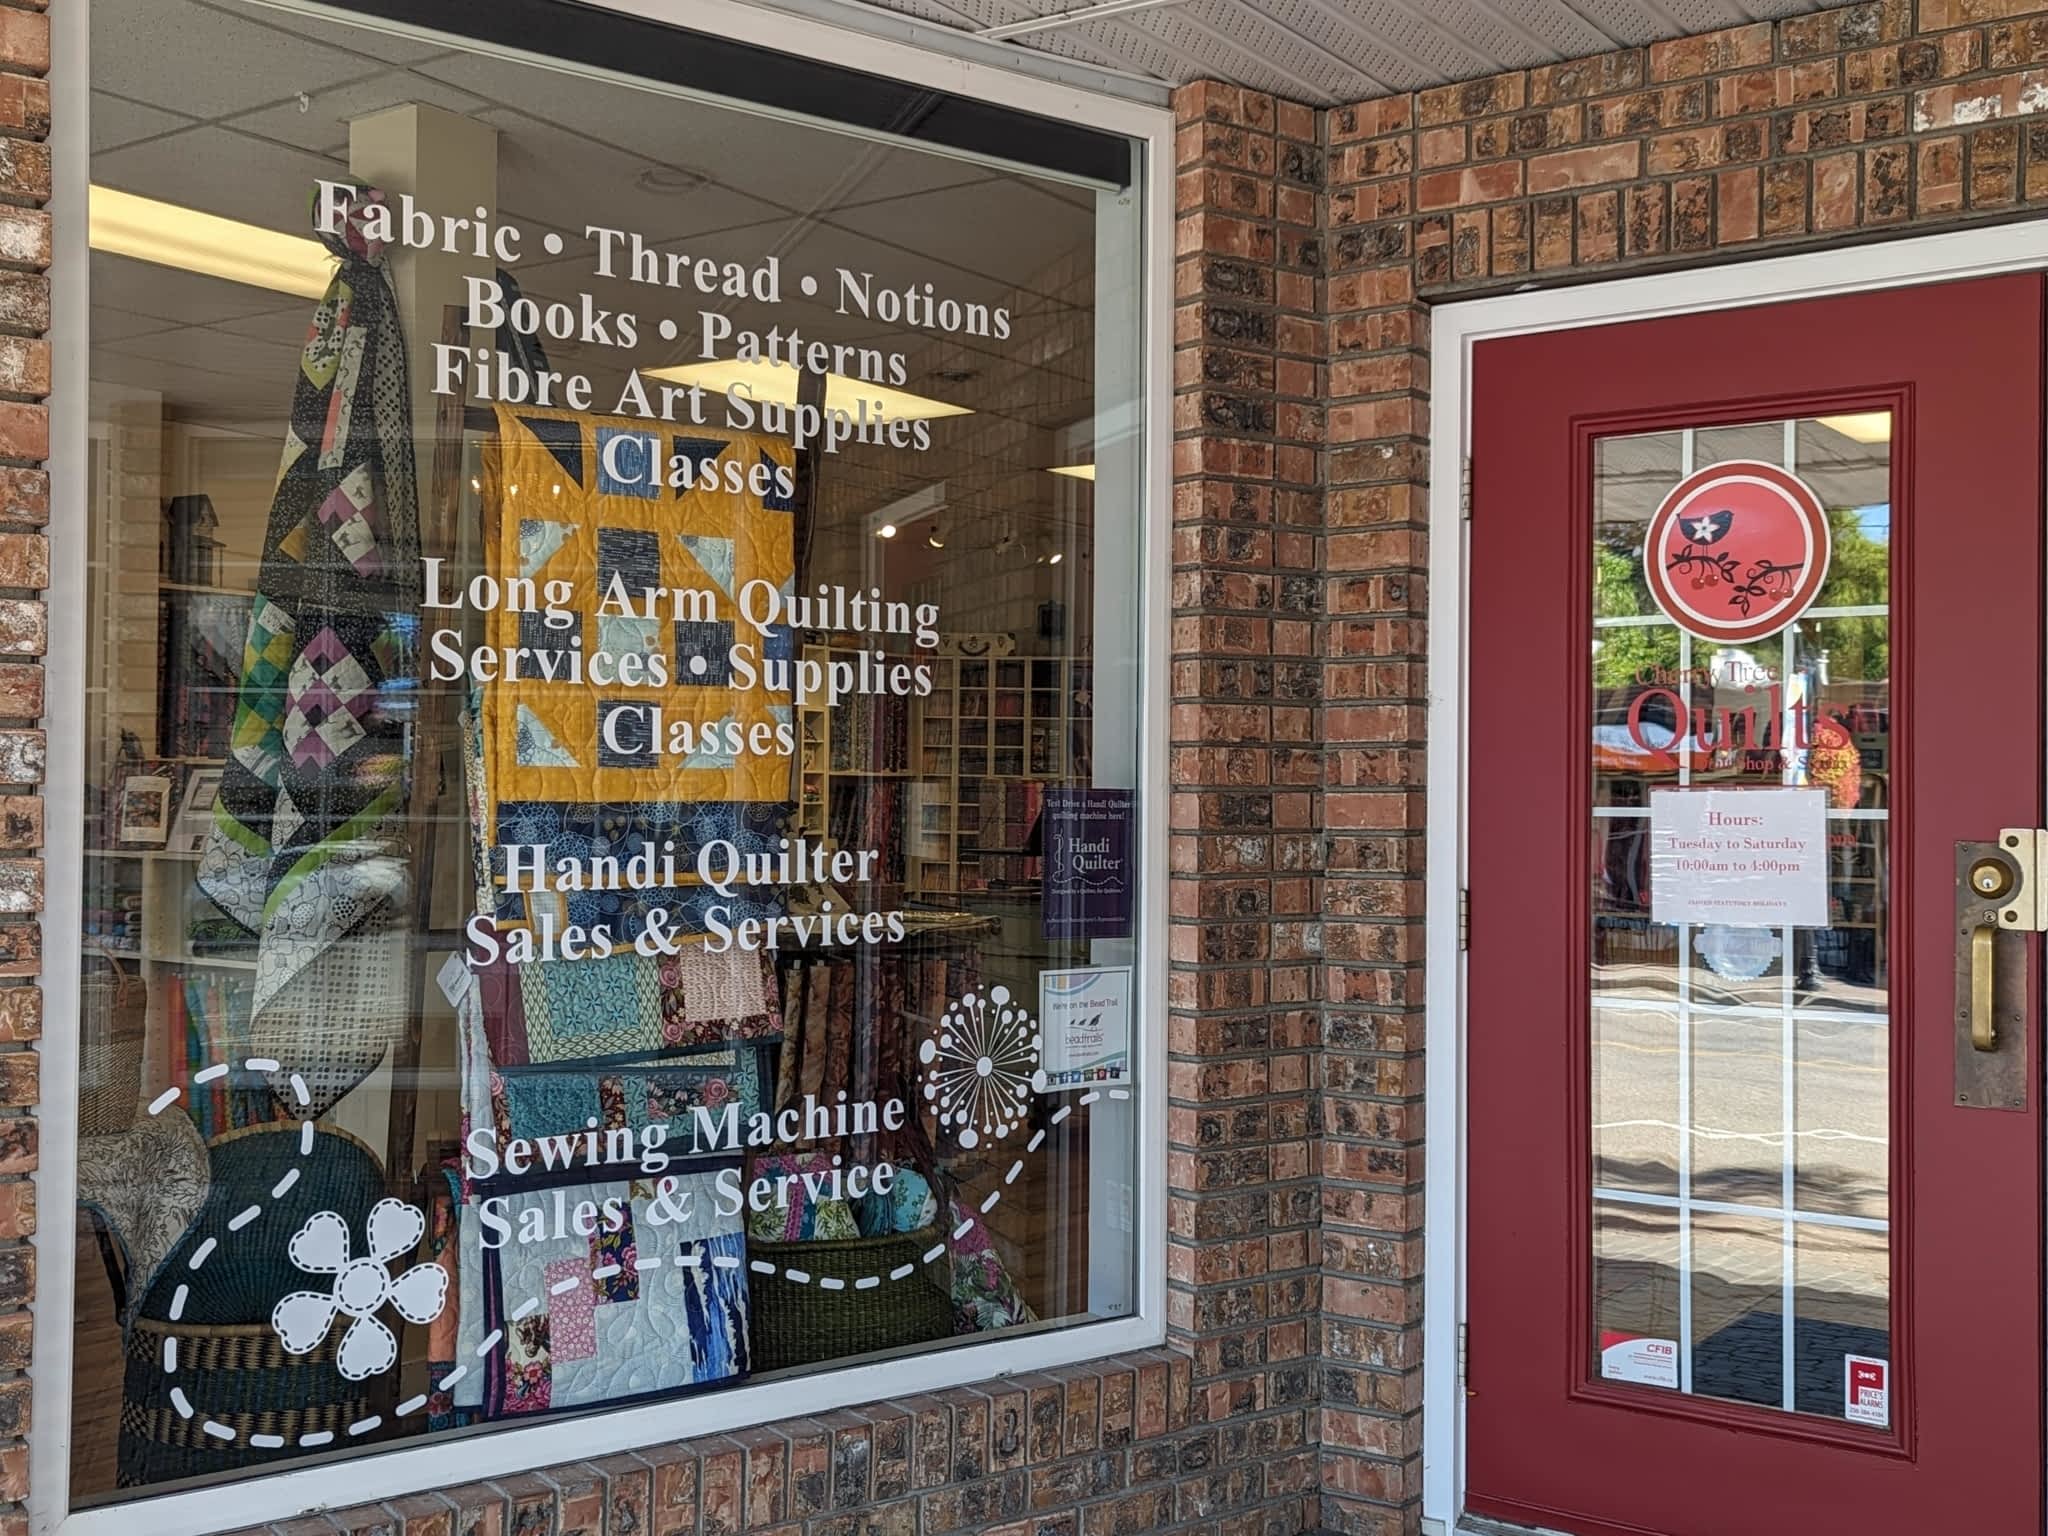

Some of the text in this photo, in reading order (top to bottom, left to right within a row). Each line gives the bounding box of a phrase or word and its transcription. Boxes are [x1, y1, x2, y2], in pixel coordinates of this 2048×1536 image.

[314, 179, 1010, 339] Fabric Thread Notions
[463, 275, 907, 385] Books Patterns
[431, 343, 931, 453] Fibre Art Supplies
[602, 434, 793, 499] Classes
[420, 557, 939, 648] Long Arm Quilting
[431, 629, 932, 706] Services Supplies
[1635, 660, 1779, 689] Cherry Tree
[602, 705, 795, 755] Classes
[1627, 683, 1851, 769] Quilts
[1080, 811, 1107, 820] machine
[1108, 810, 1125, 820] here!
[1087, 799, 1107, 808] Handi
[1108, 799, 1130, 809] Quilter
[1707, 811, 1763, 826] Hours:
[502, 839, 879, 897] Handi Quilter
[1068, 837, 1110, 853] Handi
[1072, 855, 1121, 873] Quilter
[1668, 837, 1806, 853] Tuesday to Saturday
[1676, 859, 1800, 874] 10:00am to 4:00pm
[465, 901, 905, 967] Sales & Services
[1089, 999, 1105, 1008] Bead
[465, 1090, 905, 1180] Sewing Machine
[478, 1155, 896, 1250] Sales & Service
[1647, 1344, 1673, 1355] CFIB
[1860, 1398, 1884, 1408] ALARMS
